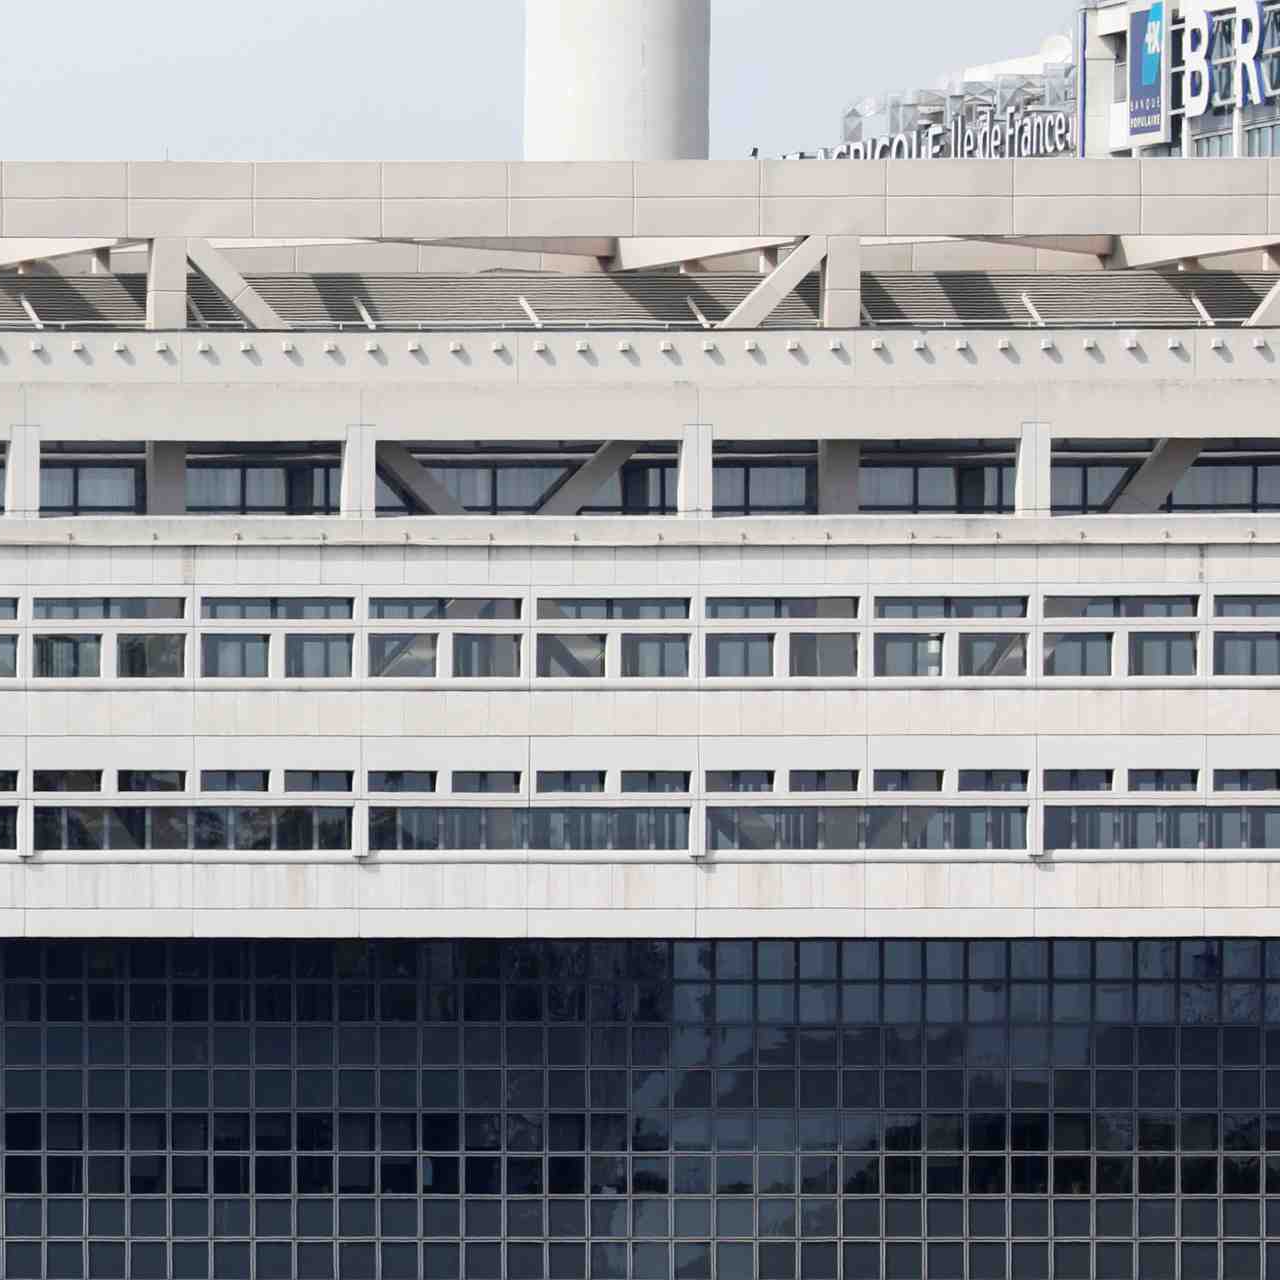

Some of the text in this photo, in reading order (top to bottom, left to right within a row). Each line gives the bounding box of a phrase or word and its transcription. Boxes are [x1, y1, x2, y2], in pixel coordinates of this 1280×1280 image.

[817, 124, 943, 160] ICOLE
[980, 110, 1001, 160] de
[1005, 106, 1065, 159] France
[1129, 114, 1160, 129] POPULAIRE
